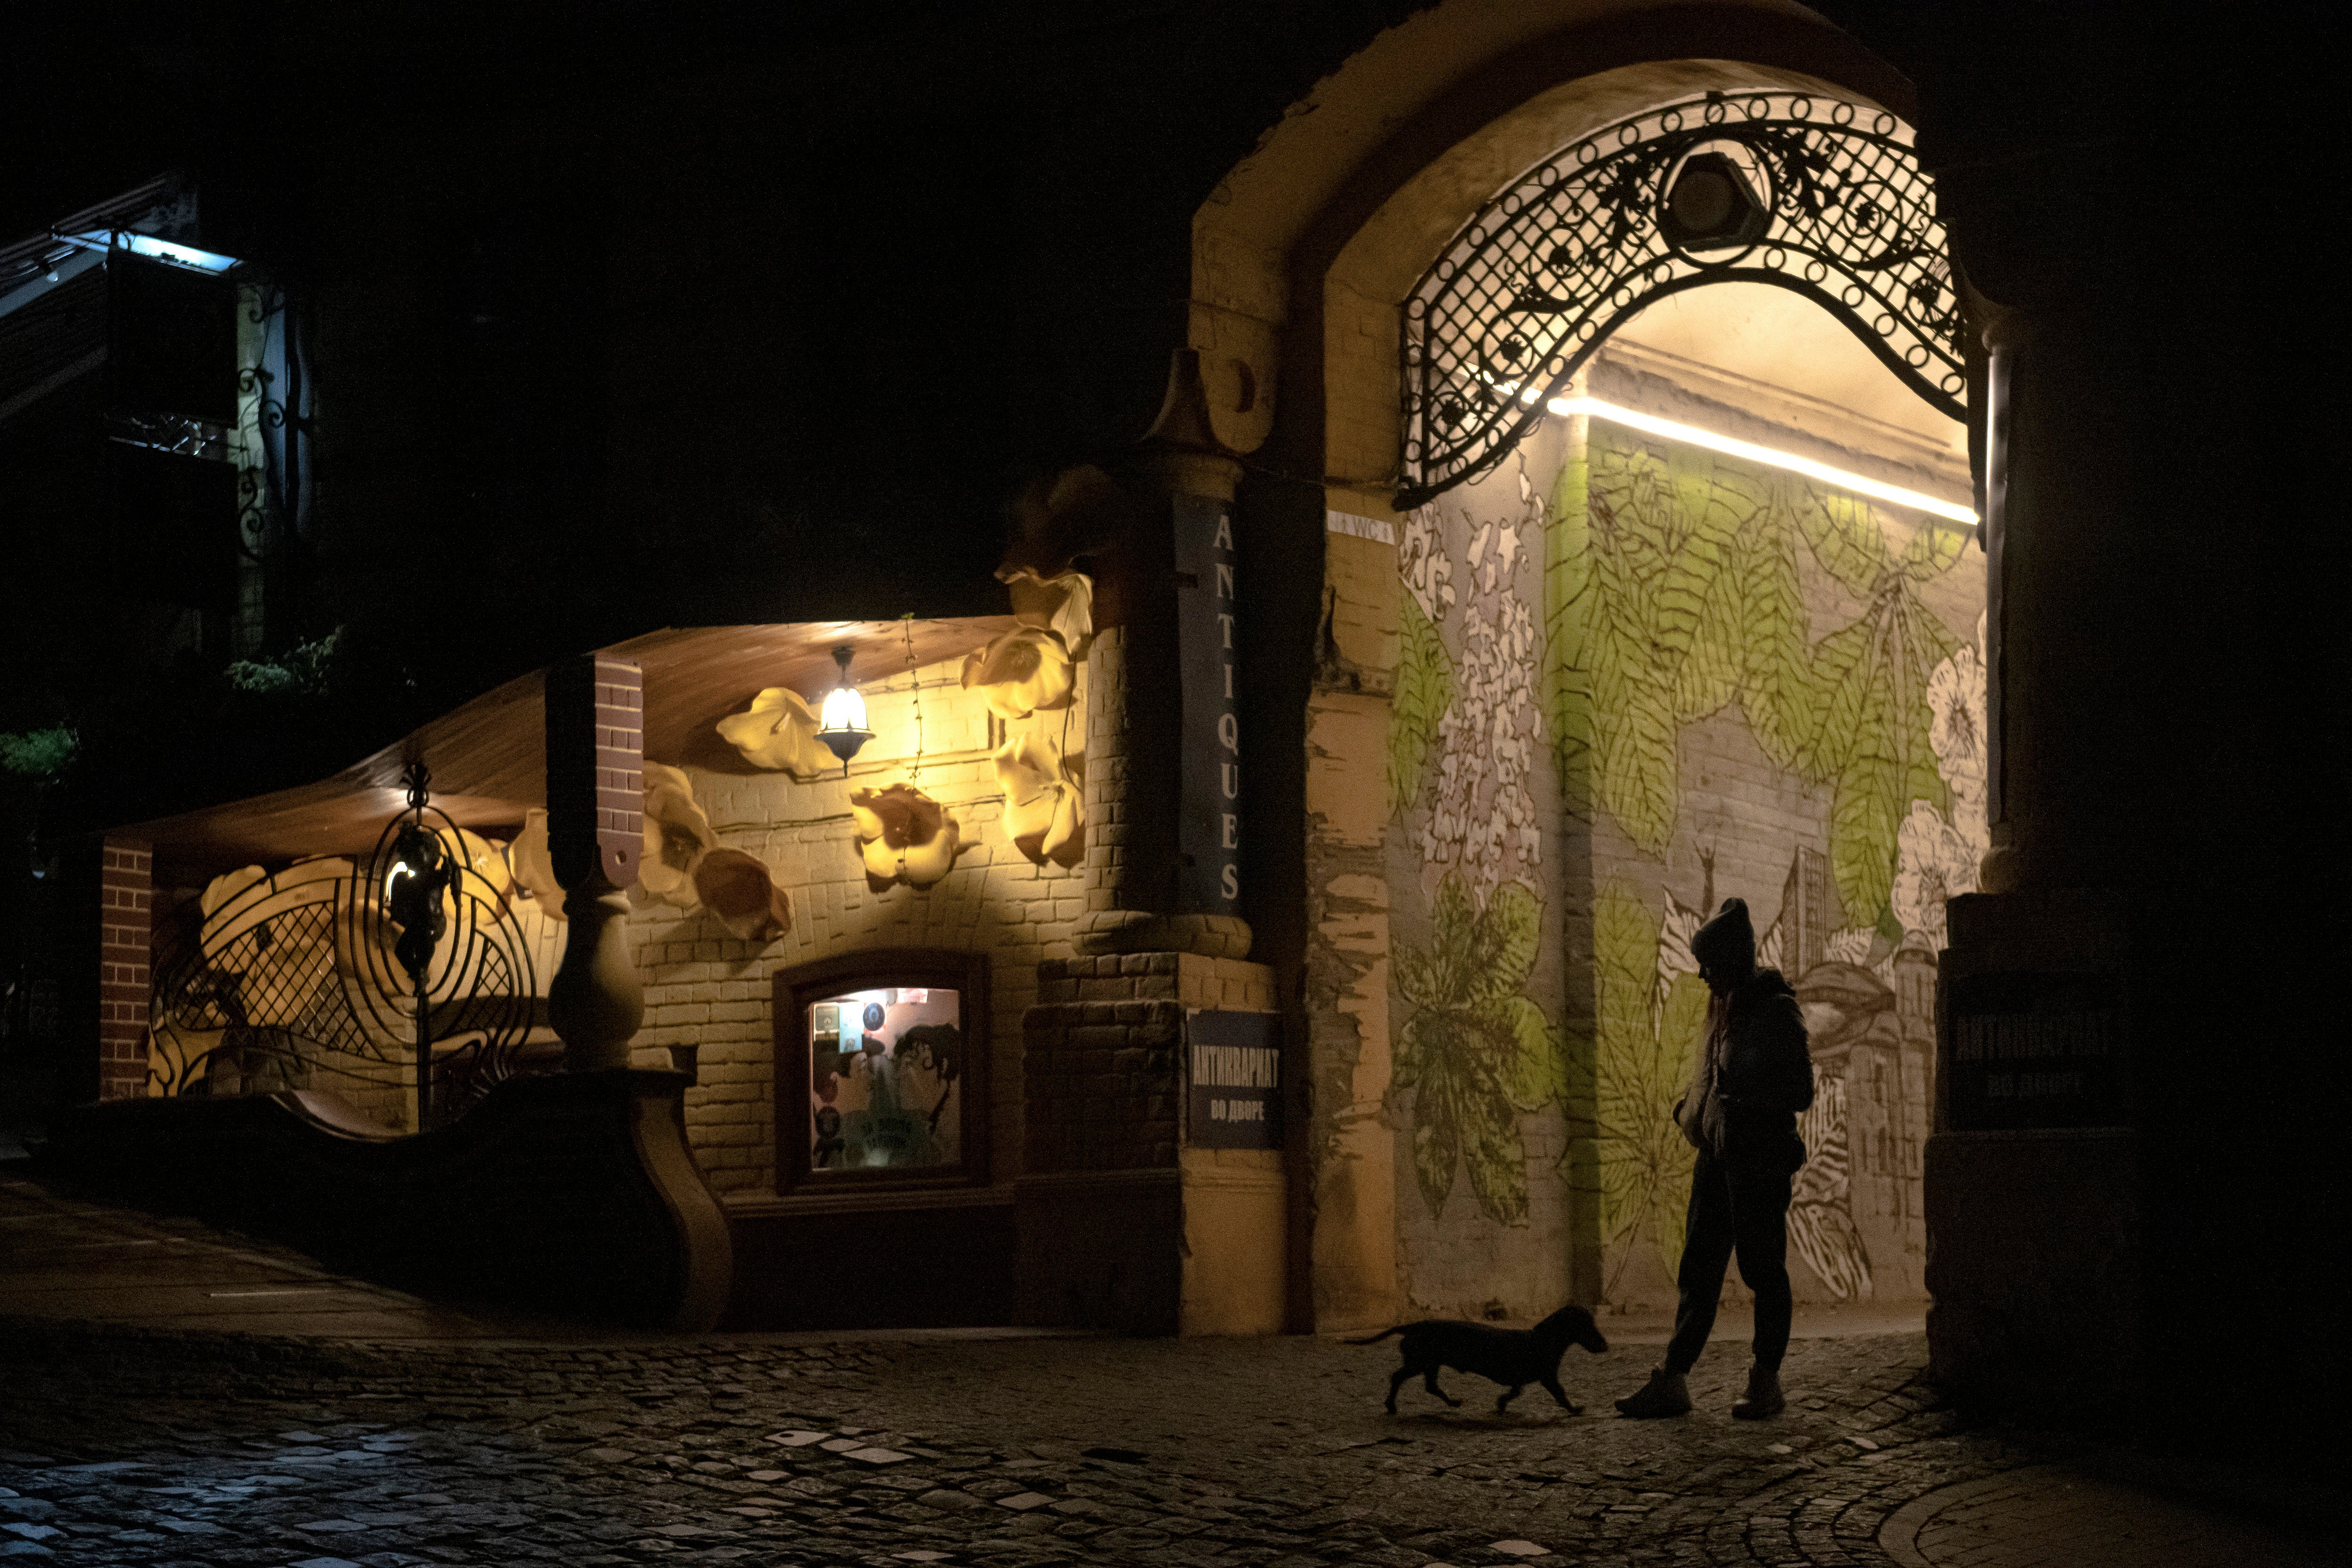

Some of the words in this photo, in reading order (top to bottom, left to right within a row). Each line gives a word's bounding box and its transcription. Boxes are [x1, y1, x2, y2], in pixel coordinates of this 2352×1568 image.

[1352, 516, 1377, 540] WC
[1214, 515, 1239, 899] ANTIQUES
[1193, 1045, 1279, 1088] АНТИКВАРИАТ
[1211, 1099, 1226, 1120] ВО
[1228, 1099, 1264, 1123] ДВОРЕ
